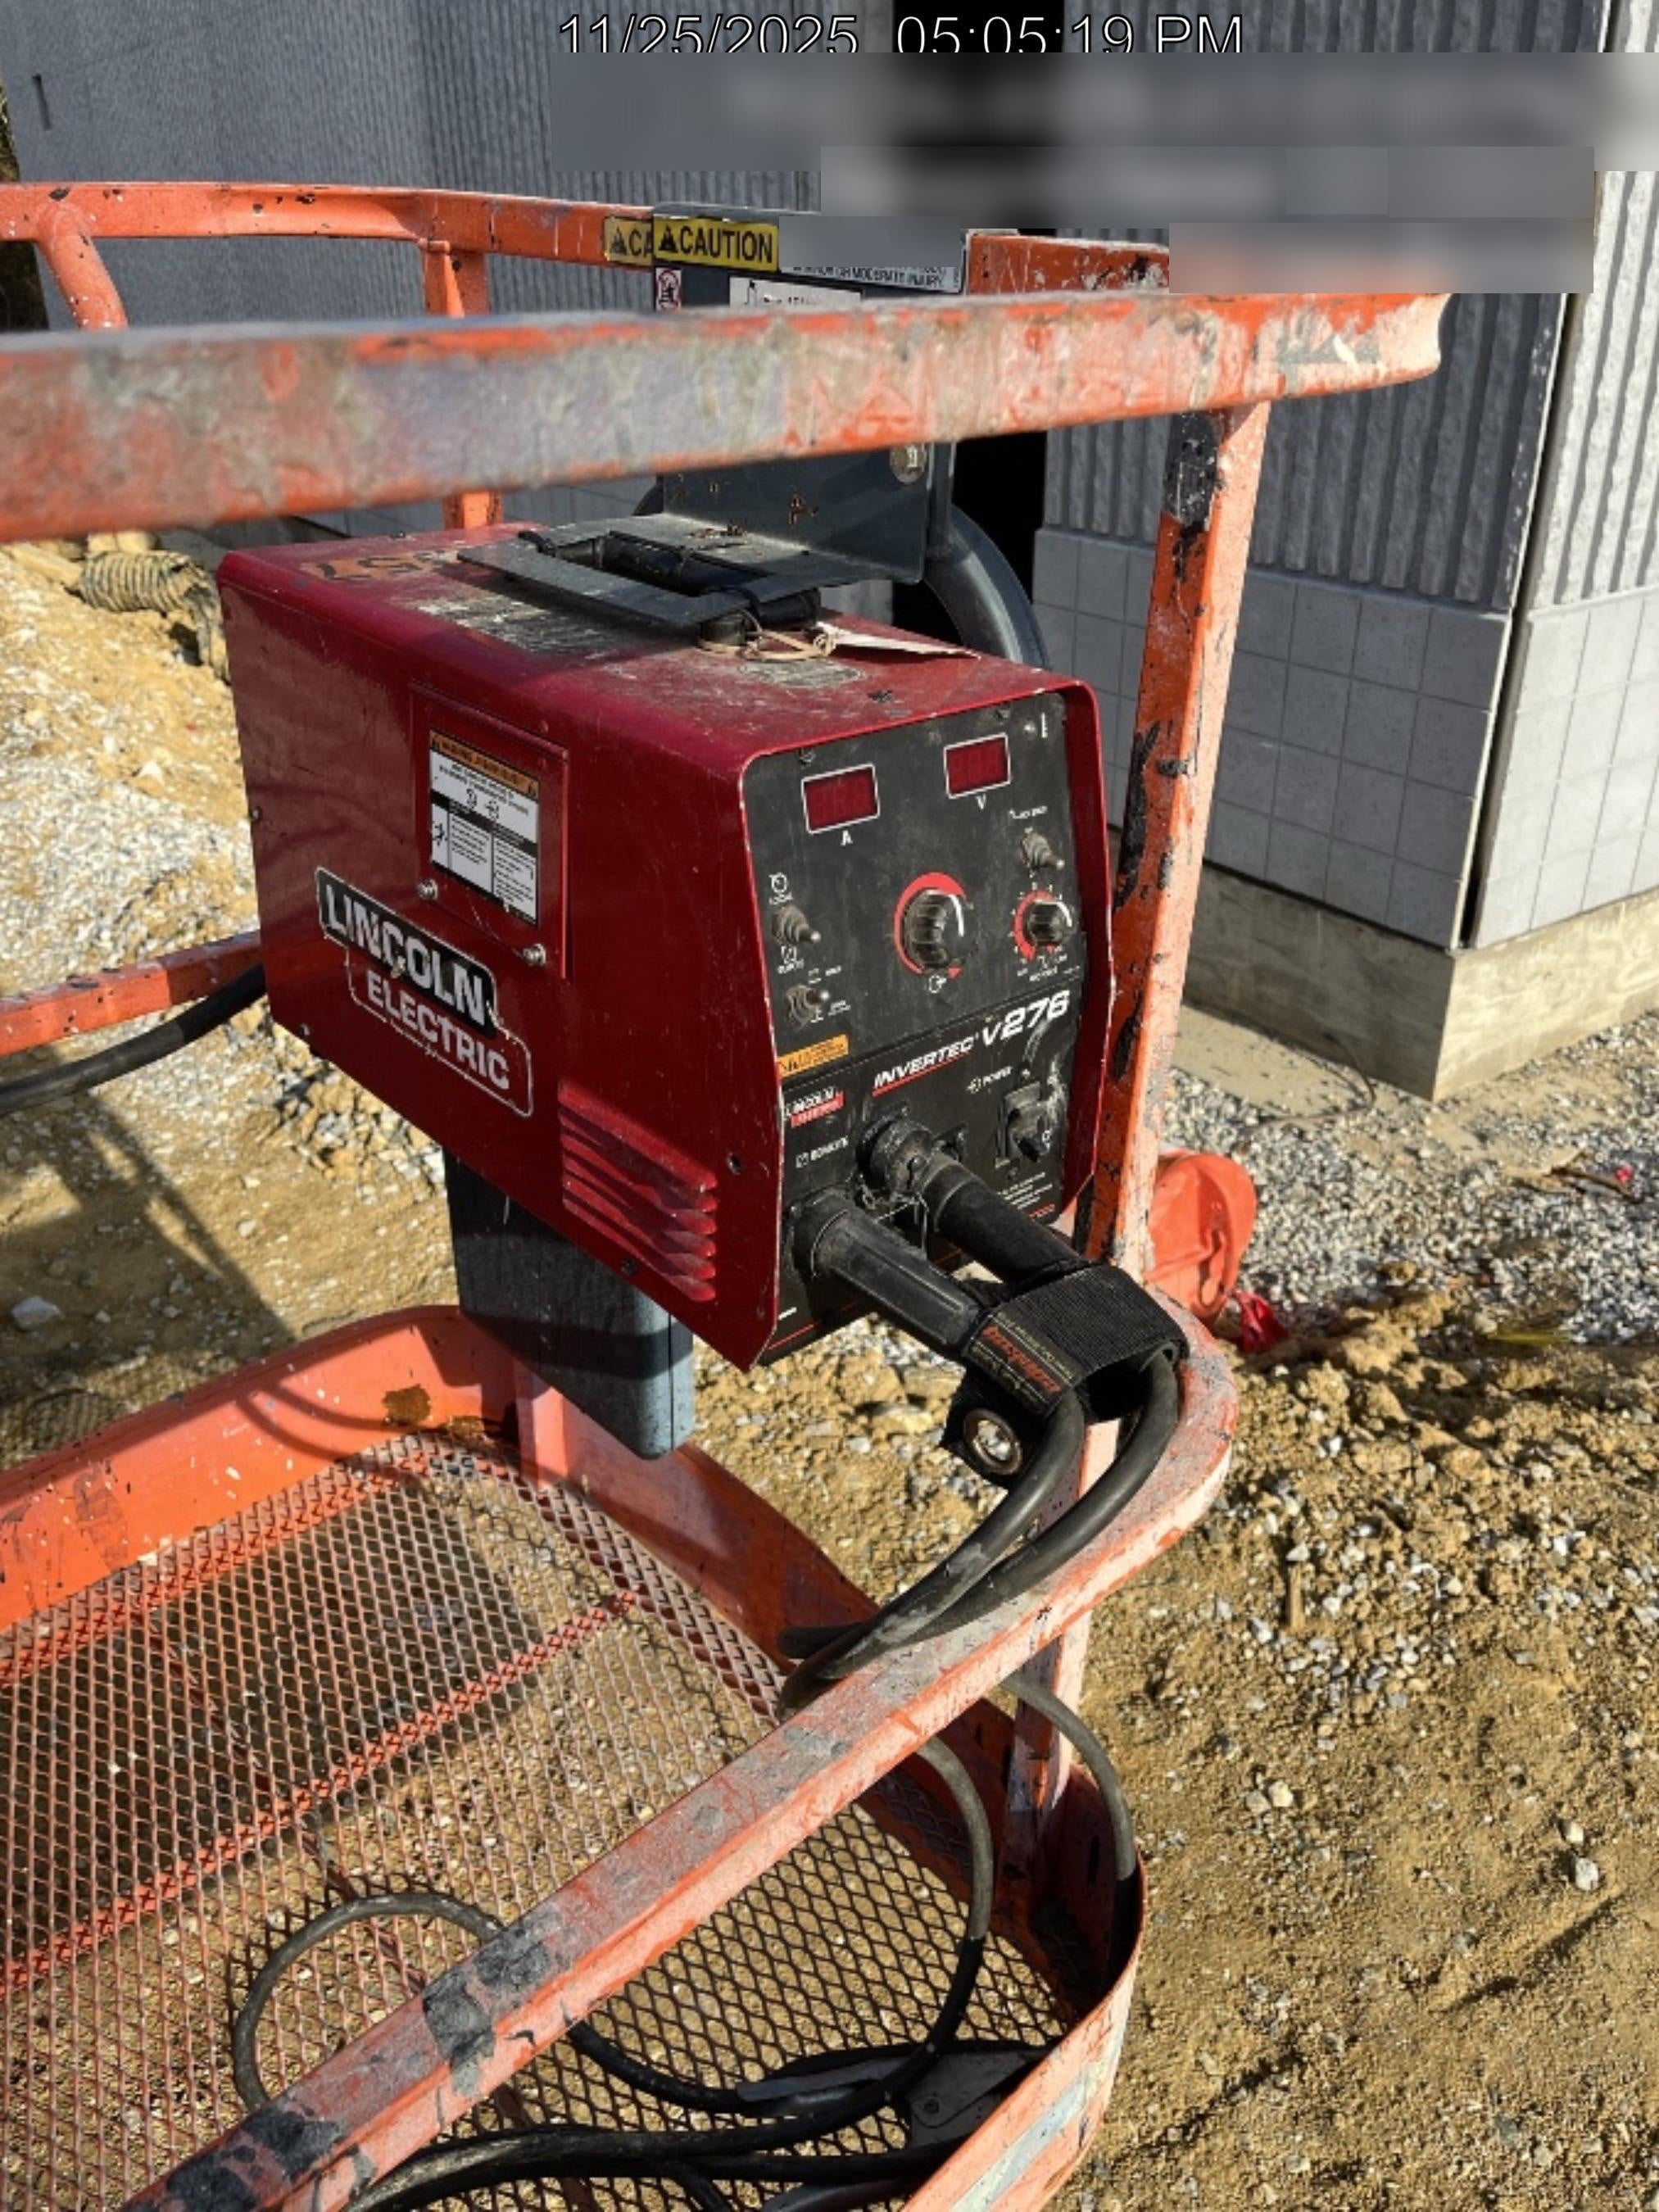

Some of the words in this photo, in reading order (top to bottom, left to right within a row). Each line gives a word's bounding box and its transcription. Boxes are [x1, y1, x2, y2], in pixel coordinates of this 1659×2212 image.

[678, 224, 773, 264] CAUTION
[326, 884, 487, 1027] LINCOLN
[367, 972, 510, 1090] ELECTRIC
[874, 1036, 974, 1088] INVERTEC
